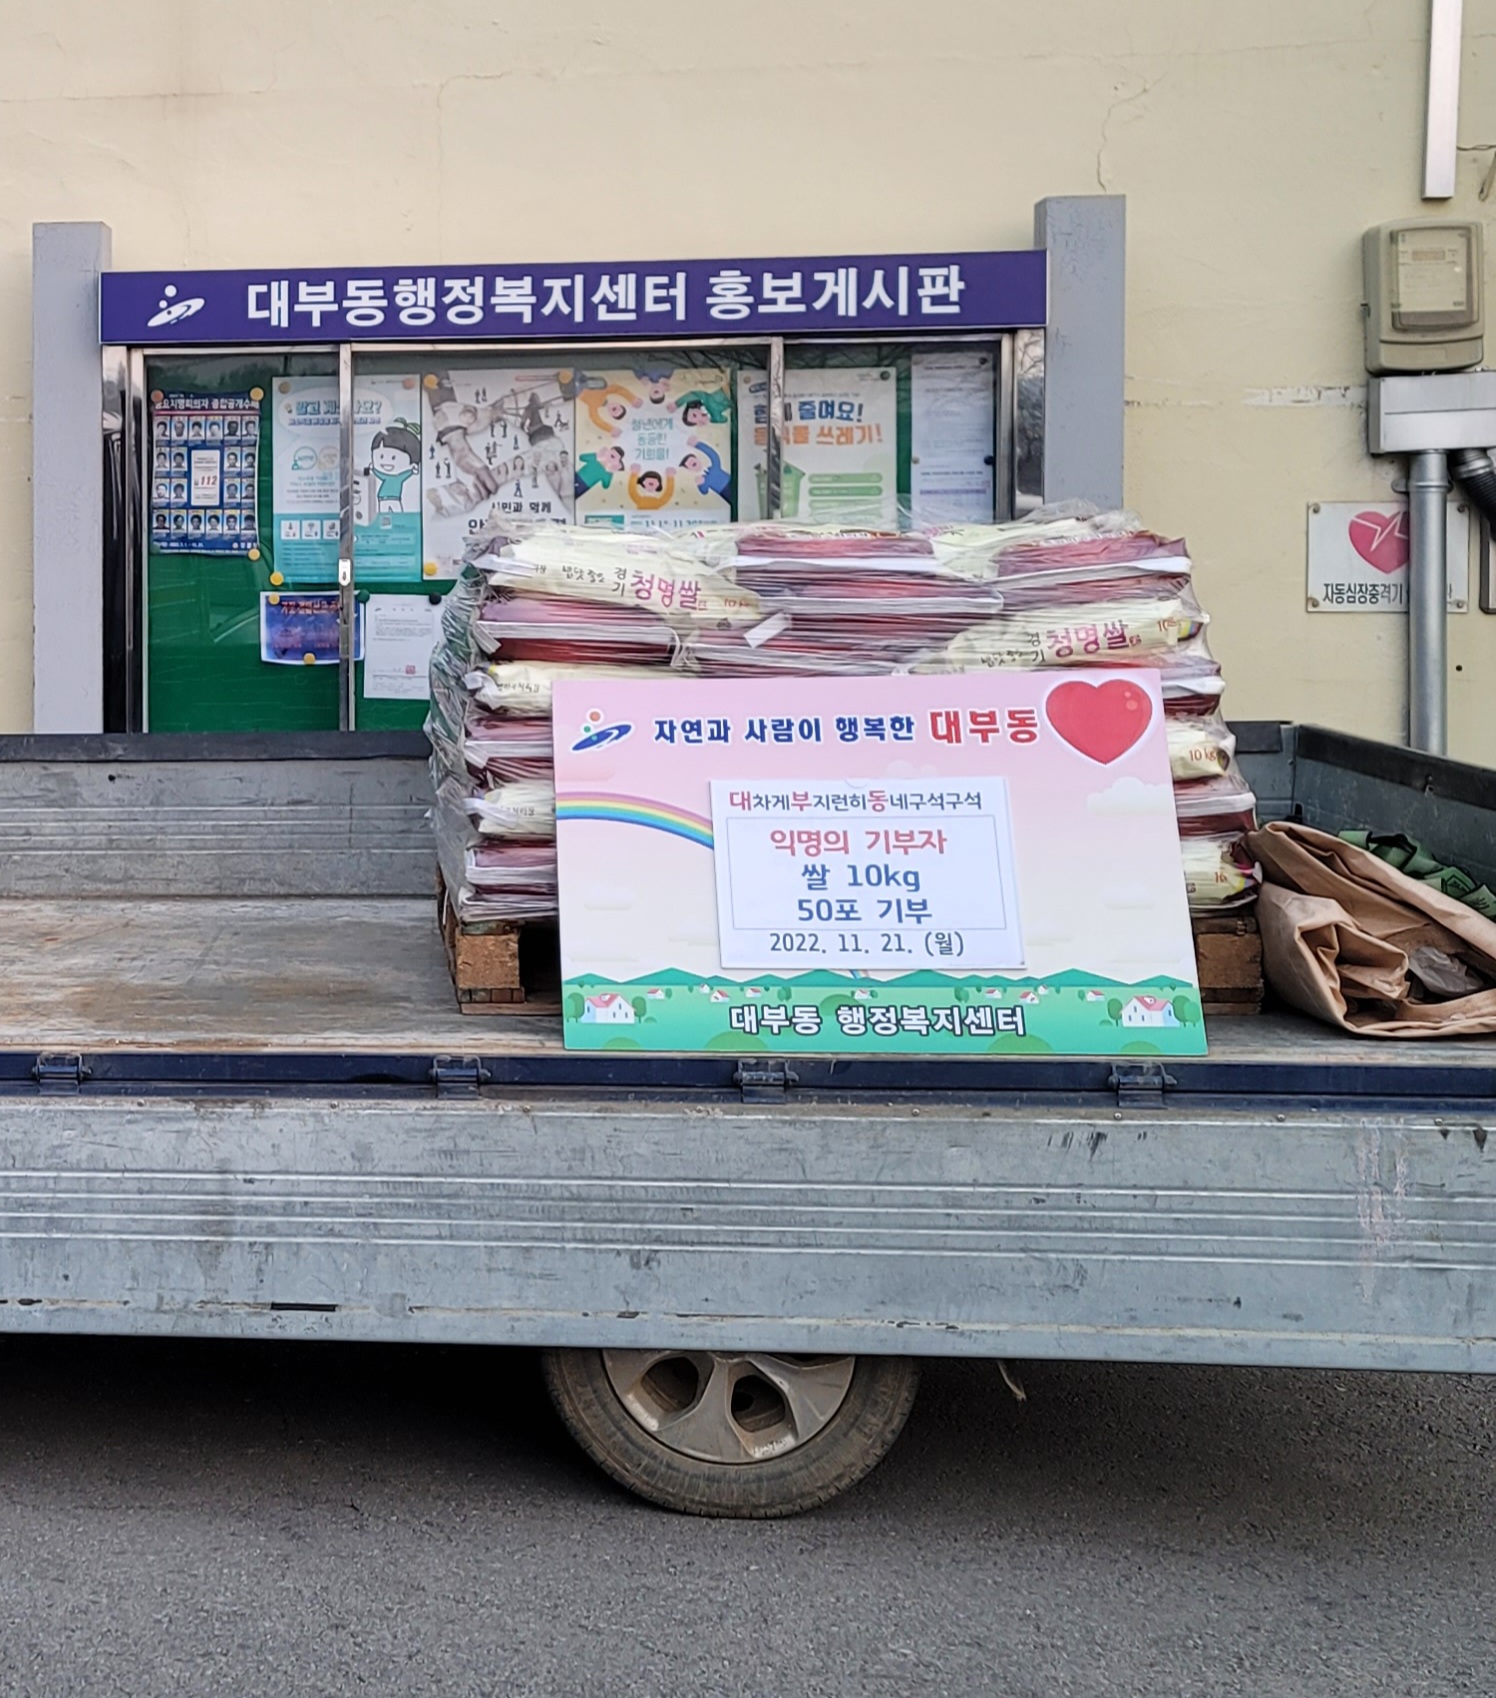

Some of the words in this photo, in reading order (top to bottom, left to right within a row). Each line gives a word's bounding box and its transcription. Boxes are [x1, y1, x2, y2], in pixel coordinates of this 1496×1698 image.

[247, 272, 687, 327] 대부동행정복지센터
[706, 265, 966, 320] 홍보게시판
[798, 399, 863, 422] 줄여요!
[815, 423, 883, 446] 쓰레기!
[630, 569, 702, 611] 청명쌀
[653, 718, 731, 744] 자연과
[744, 717, 822, 743] 사람이
[835, 715, 915, 742] 행복한
[929, 708, 1039, 744] 대부동
[729, 790, 983, 813] 대차게부지런히동네구석구석
[769, 829, 850, 857] 익명의
[864, 829, 948, 856] 기부자
[800, 863, 831, 891] 쌀
[846, 863, 921, 893] 10kg
[797, 898, 862, 922] 50포
[877, 898, 933, 925] 기부
[769, 932, 827, 954] 2022.
[838, 932, 870, 954] 11.
[881, 932, 913, 954] 21.
[924, 931, 965, 957] (월)
[729, 1005, 822, 1035] 대부동
[836, 1004, 1027, 1036] 행정복지센터
